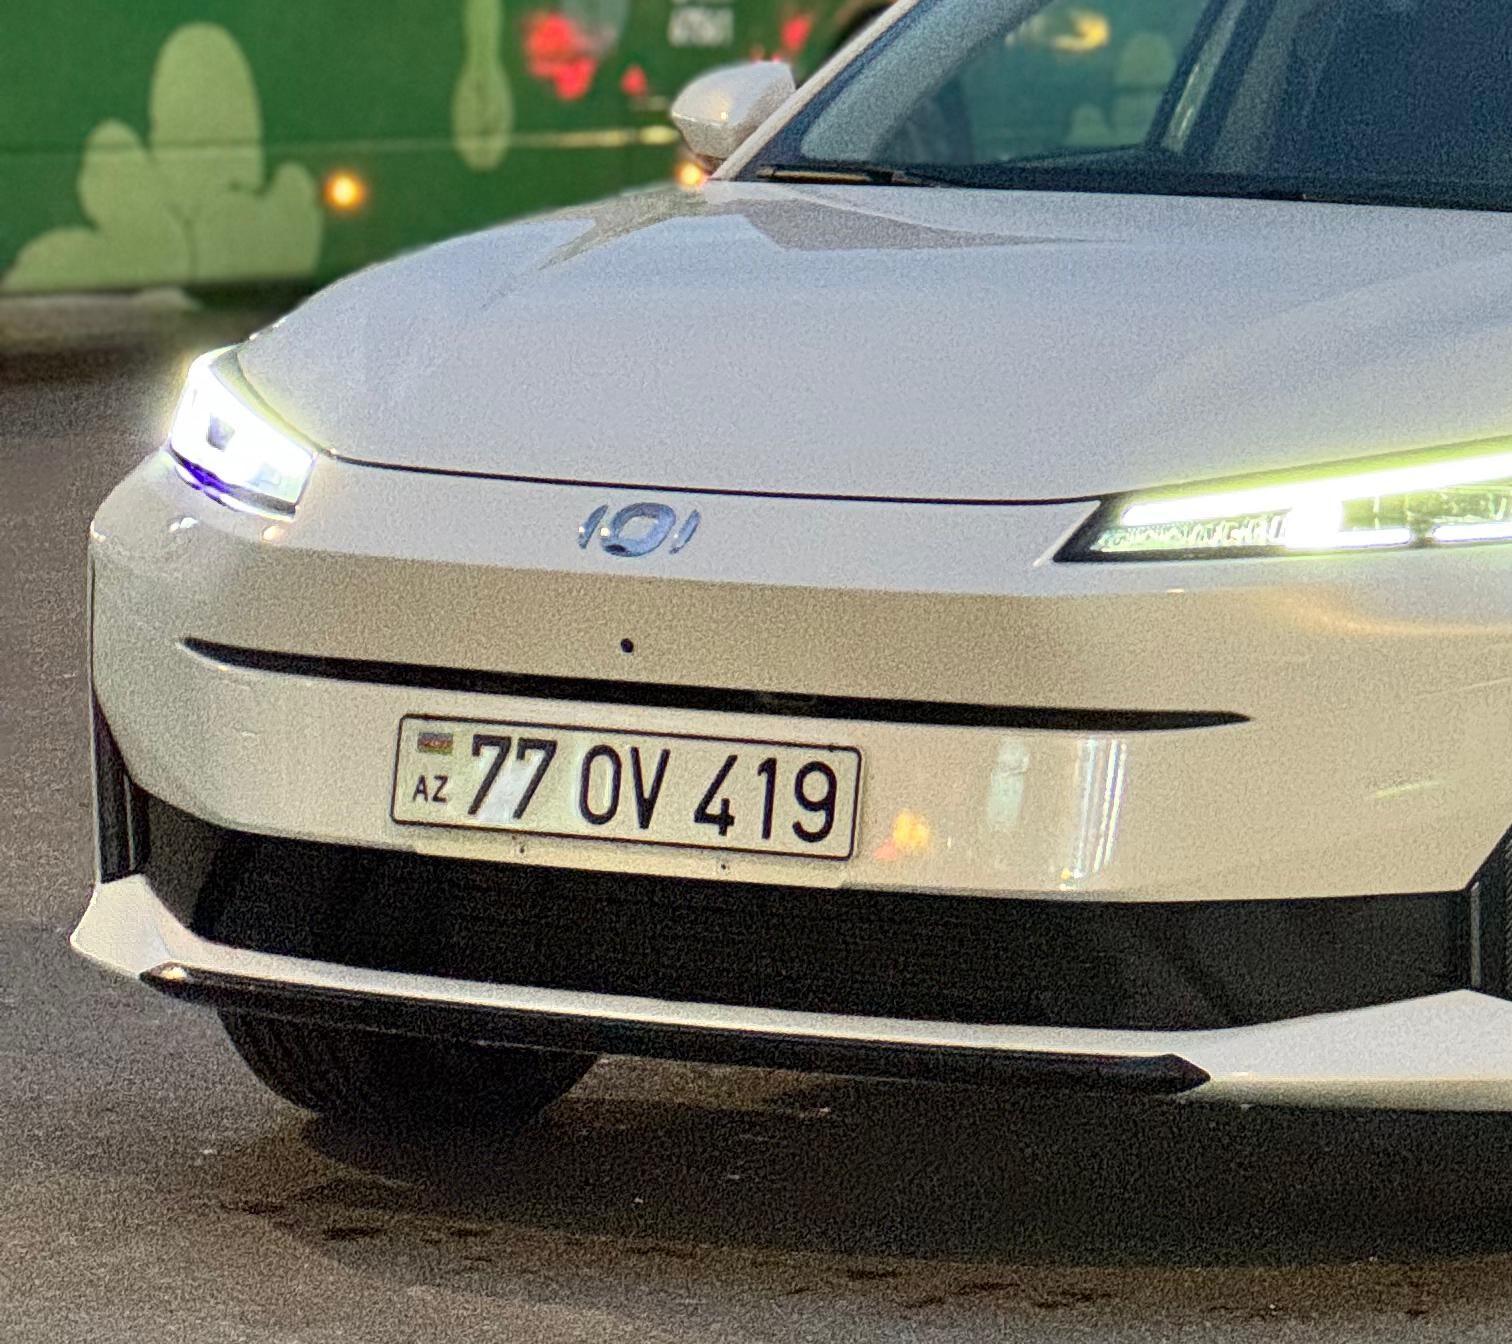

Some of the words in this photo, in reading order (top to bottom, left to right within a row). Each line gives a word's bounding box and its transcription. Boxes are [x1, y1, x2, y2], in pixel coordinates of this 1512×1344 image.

[412, 774, 448, 803] AZ
[467, 733, 558, 820] 77
[693, 754, 838, 844] 419
